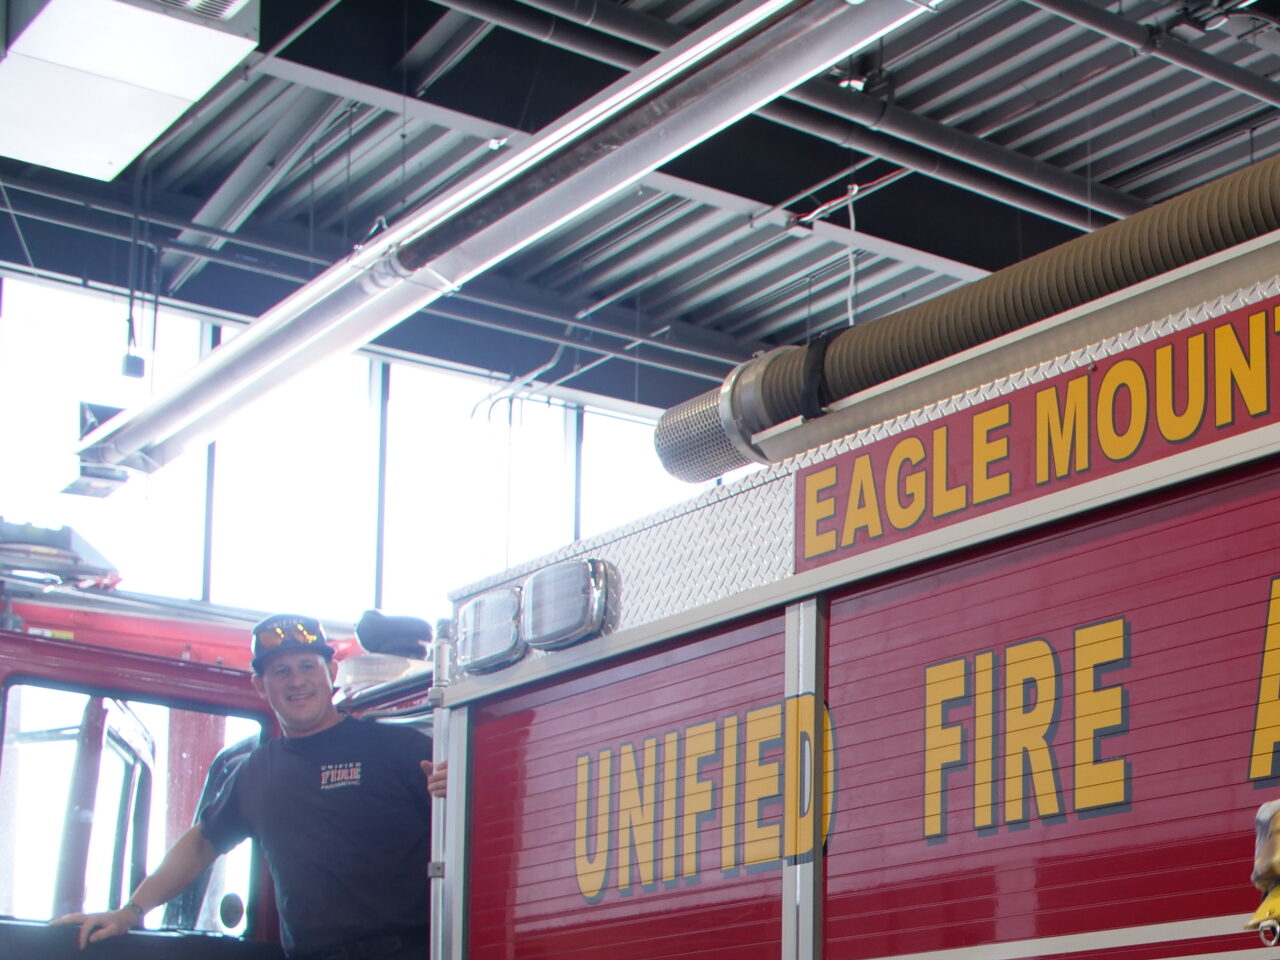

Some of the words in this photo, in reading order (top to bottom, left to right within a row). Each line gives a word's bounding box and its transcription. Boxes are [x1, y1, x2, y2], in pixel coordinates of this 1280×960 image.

[803, 402, 1011, 561] EAGLE
[320, 767, 361, 785] FIRE
[575, 691, 838, 904] UNIFIED
[922, 615, 1132, 845] FIRE
